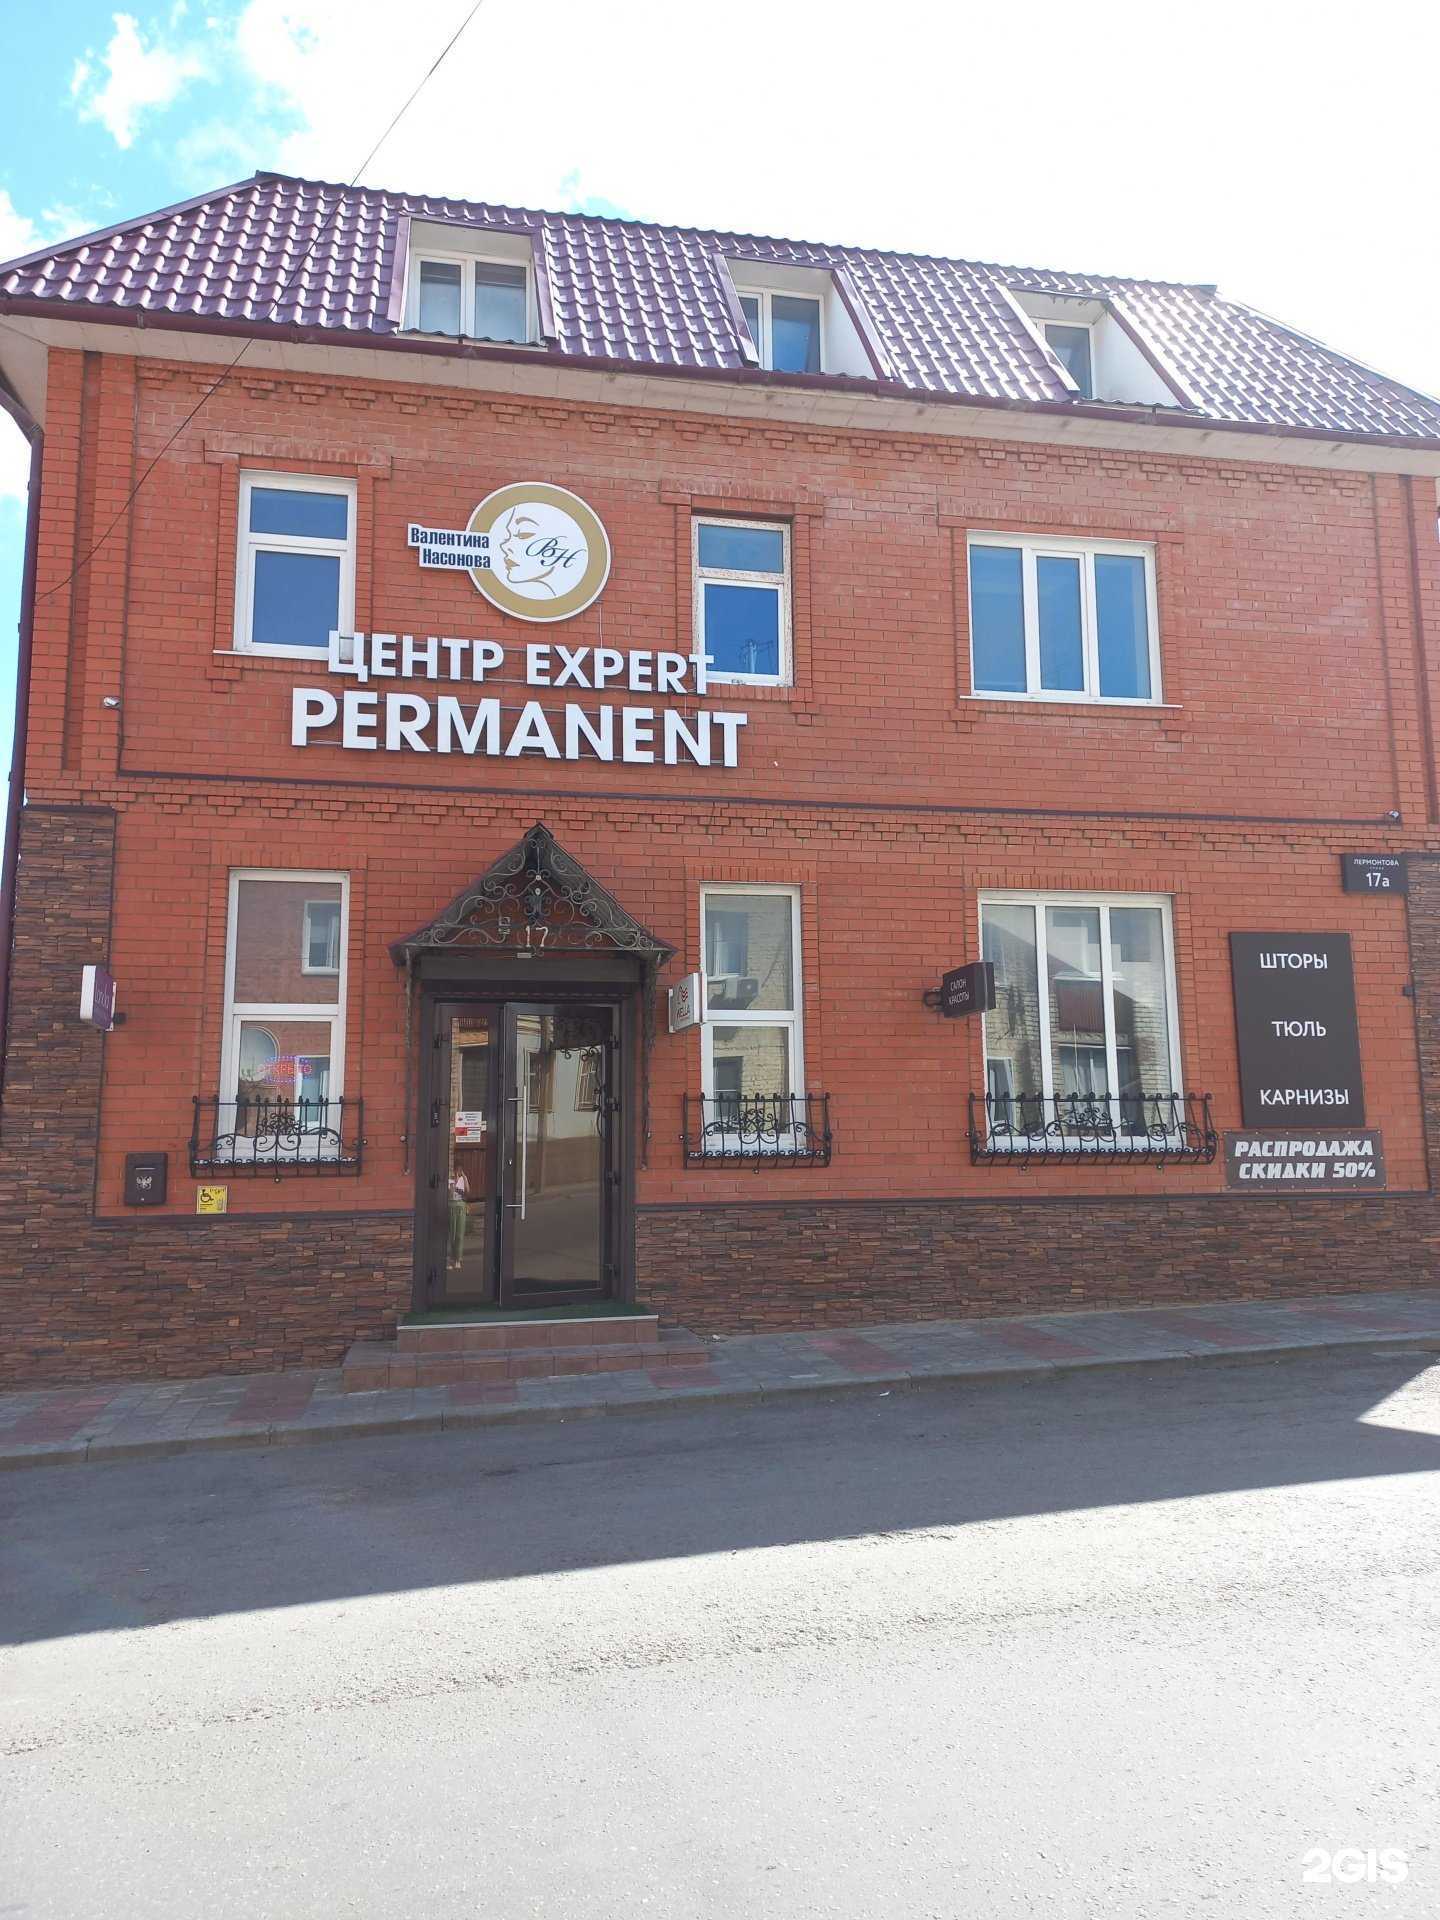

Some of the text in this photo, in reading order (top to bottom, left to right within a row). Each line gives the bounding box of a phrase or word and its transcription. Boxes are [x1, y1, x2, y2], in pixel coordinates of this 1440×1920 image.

[410, 527, 490, 549] Валентина
[422, 547, 491, 569] Насонова
[328, 630, 715, 695] ЦЕНТР EXPERT
[291, 686, 748, 768] PERMANENT
[1353, 858, 1400, 867] ЛЕРМОНТОВА
[1365, 872, 1390, 887] 17а
[525, 925, 549, 948] 17
[1259, 953, 1328, 969] ШТОРЫ
[950, 978, 967, 992] САЛОН
[948, 991, 970, 1005] КРАСОТЫ
[1271, 1021, 1327, 1037] ТЮЛЬ
[1259, 1089, 1349, 1105] КАРНИЗЫ
[1234, 1140, 1374, 1157] РАСПРОДАЖА
[1239, 1161, 1376, 1179] СКИДКИ 50%
